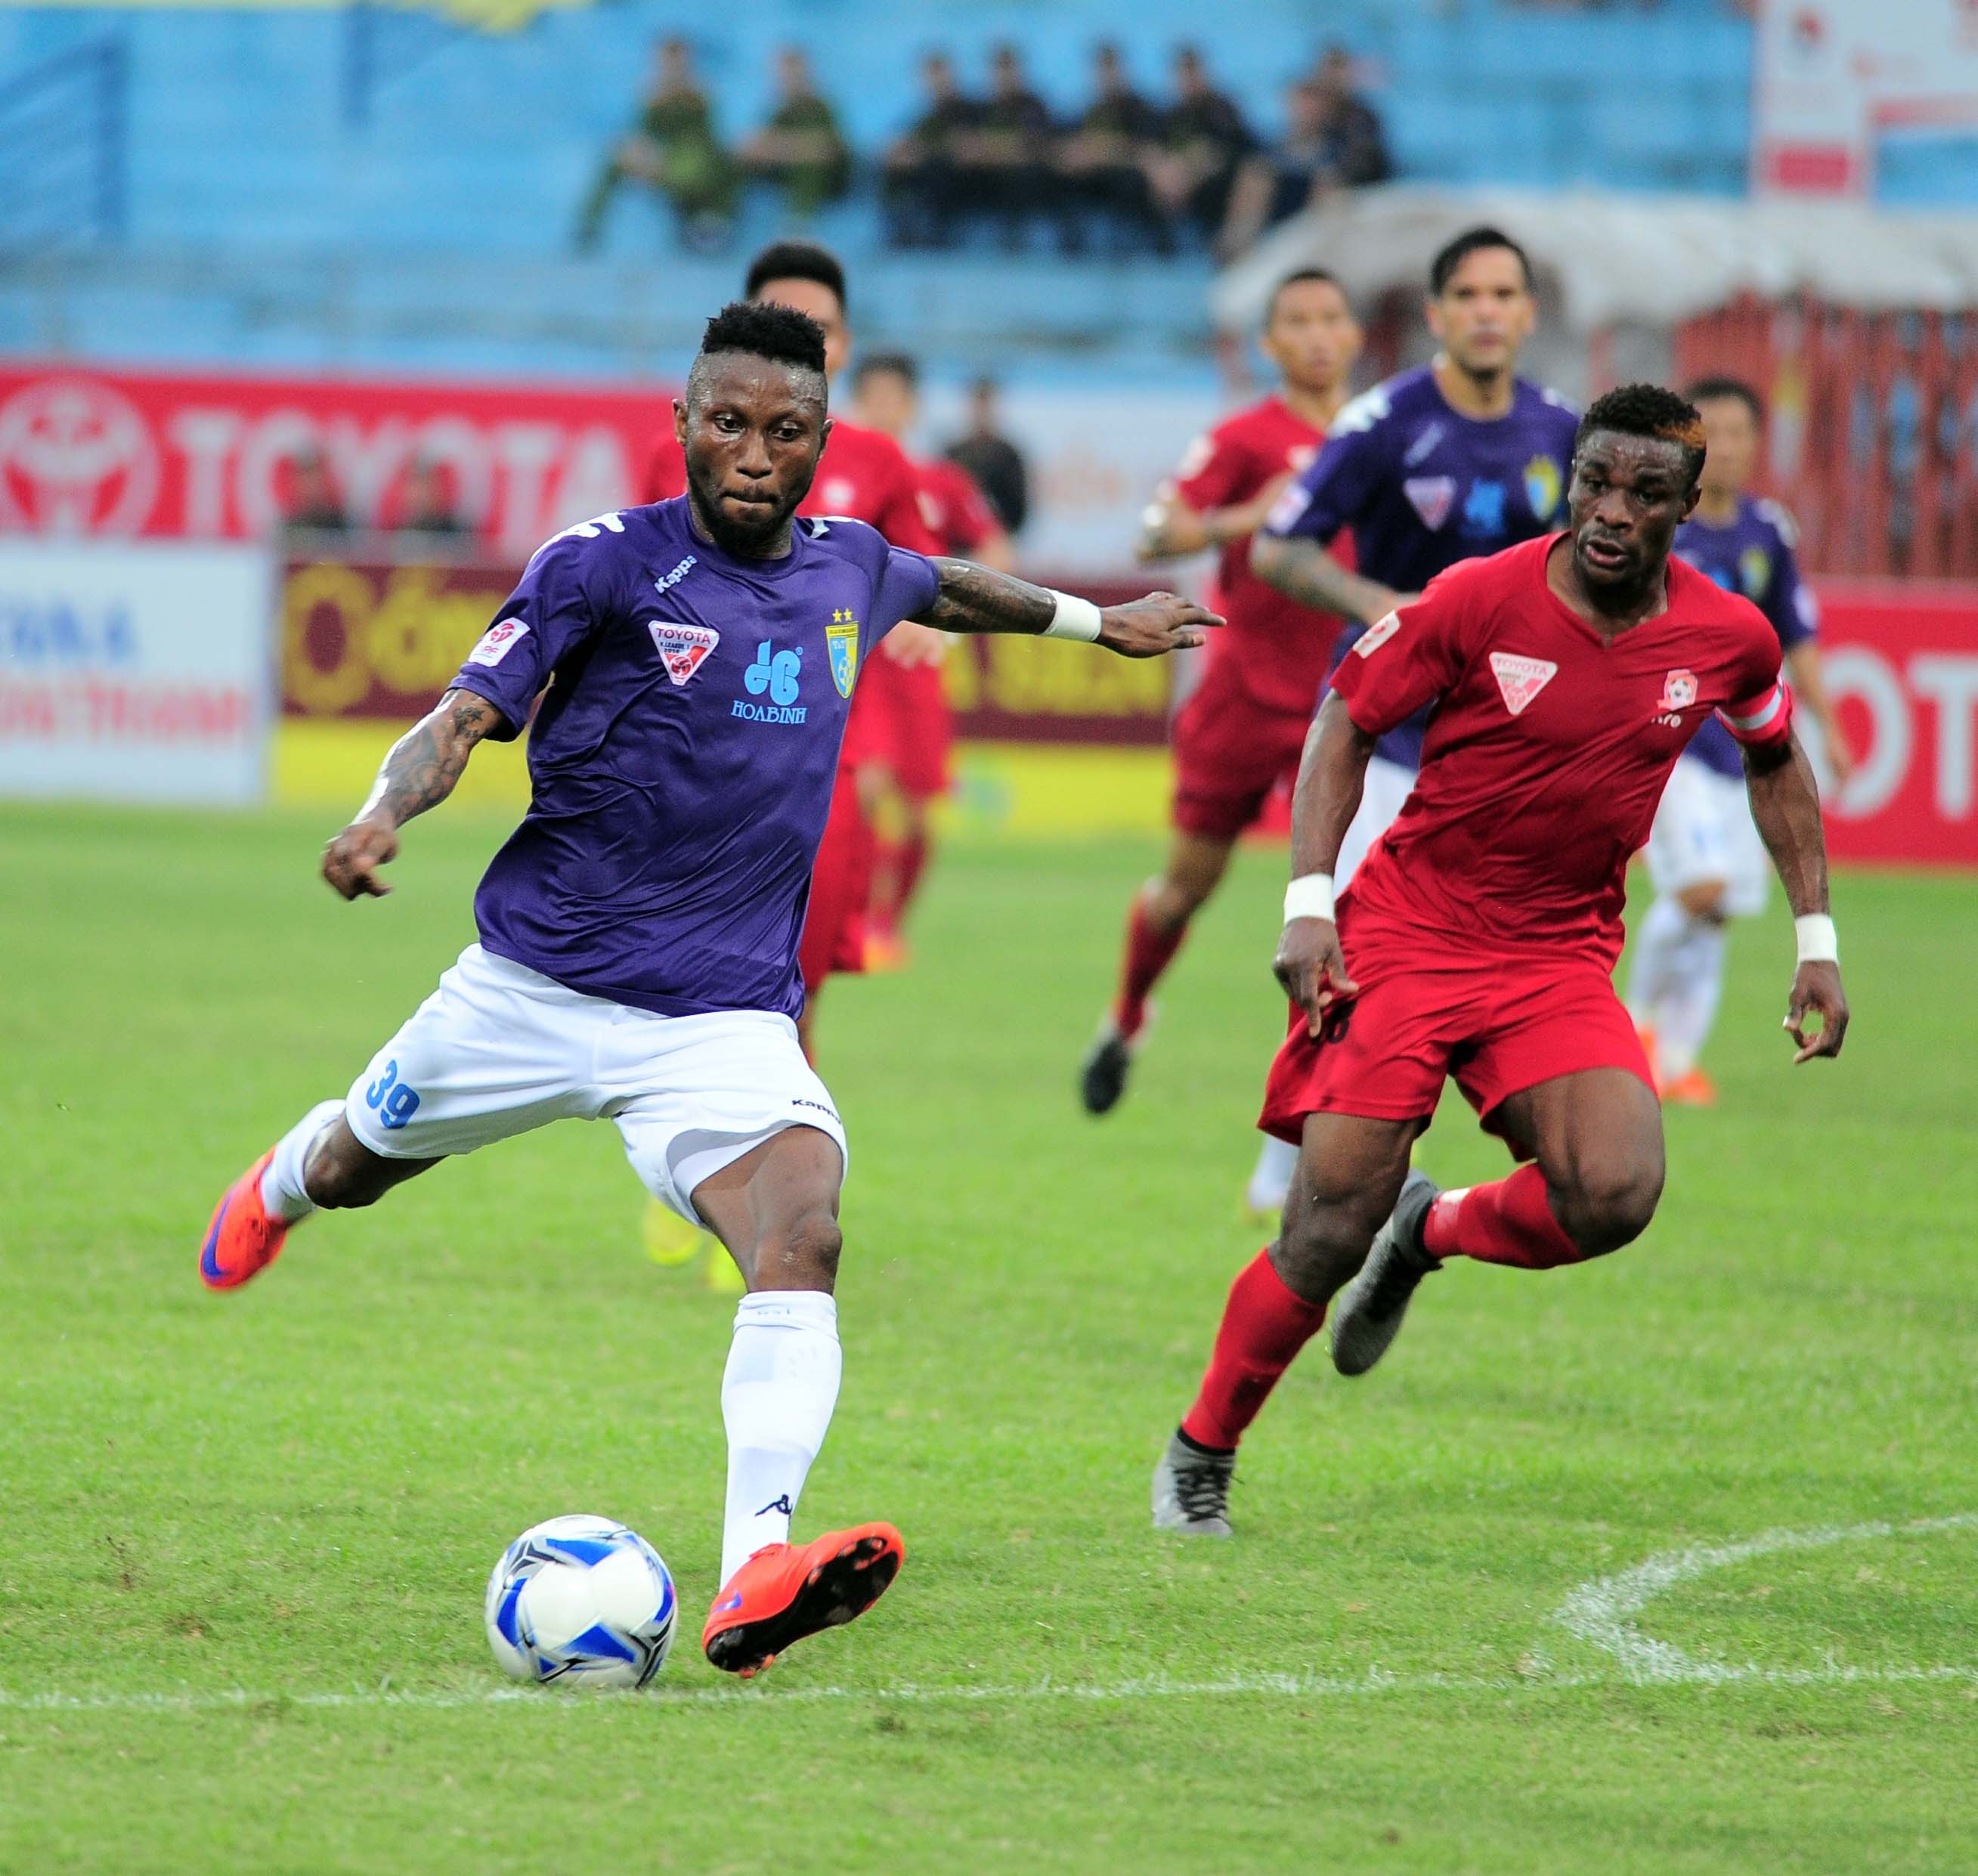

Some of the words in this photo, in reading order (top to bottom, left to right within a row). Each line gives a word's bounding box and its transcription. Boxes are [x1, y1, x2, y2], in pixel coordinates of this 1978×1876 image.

[168, 408, 636, 561] TOYOTA
[654, 555, 698, 594] Kappa
[656, 627, 711, 645] TOYOTA
[730, 699, 808, 725] HOABINH
[366, 1059, 421, 1130] 39
